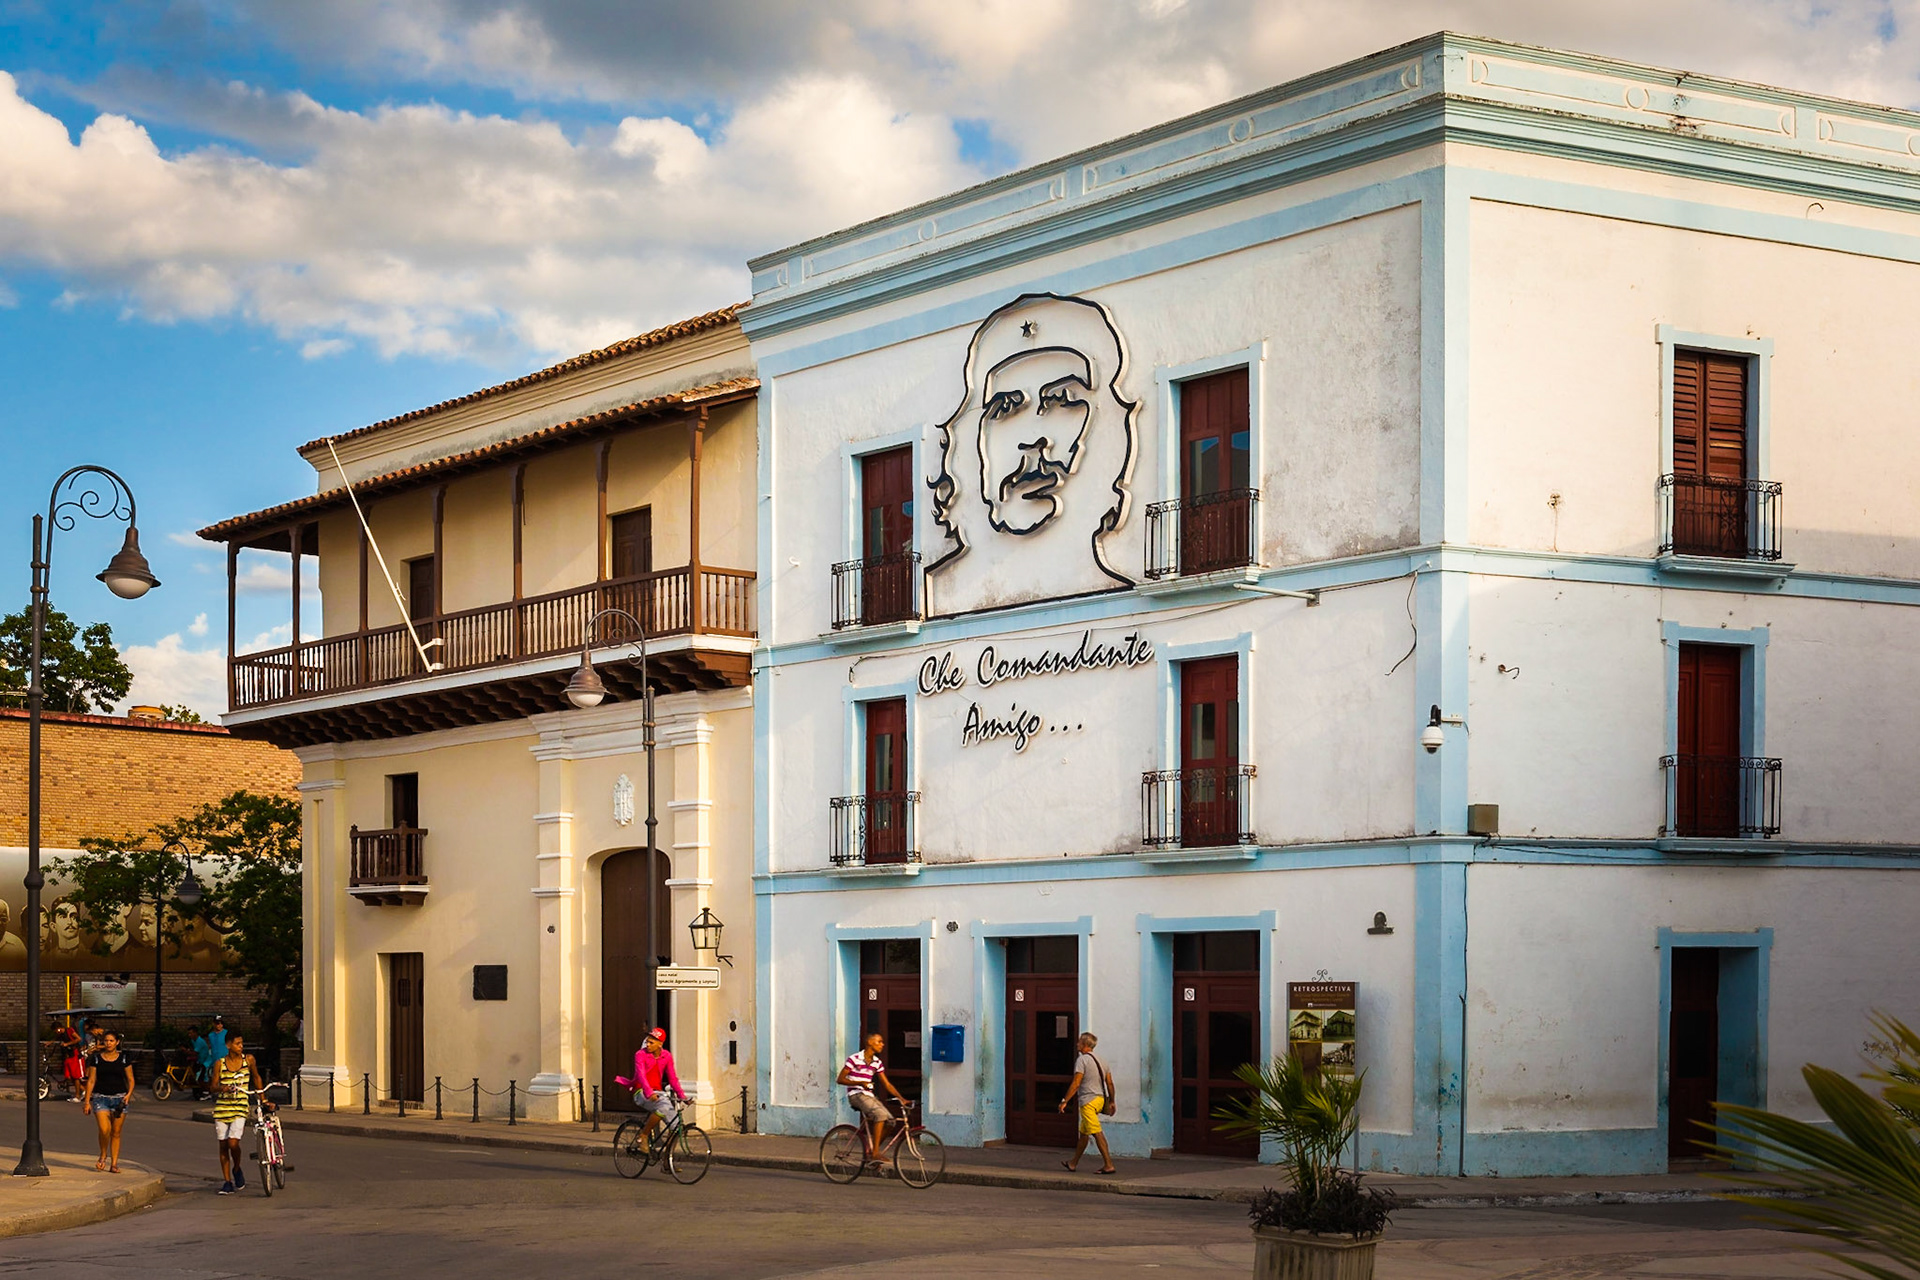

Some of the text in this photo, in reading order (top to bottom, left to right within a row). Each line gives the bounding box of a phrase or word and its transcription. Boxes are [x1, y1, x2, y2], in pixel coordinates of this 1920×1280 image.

[918, 629, 1153, 695] Che Comandante
[962, 701, 1041, 751] Amigo
